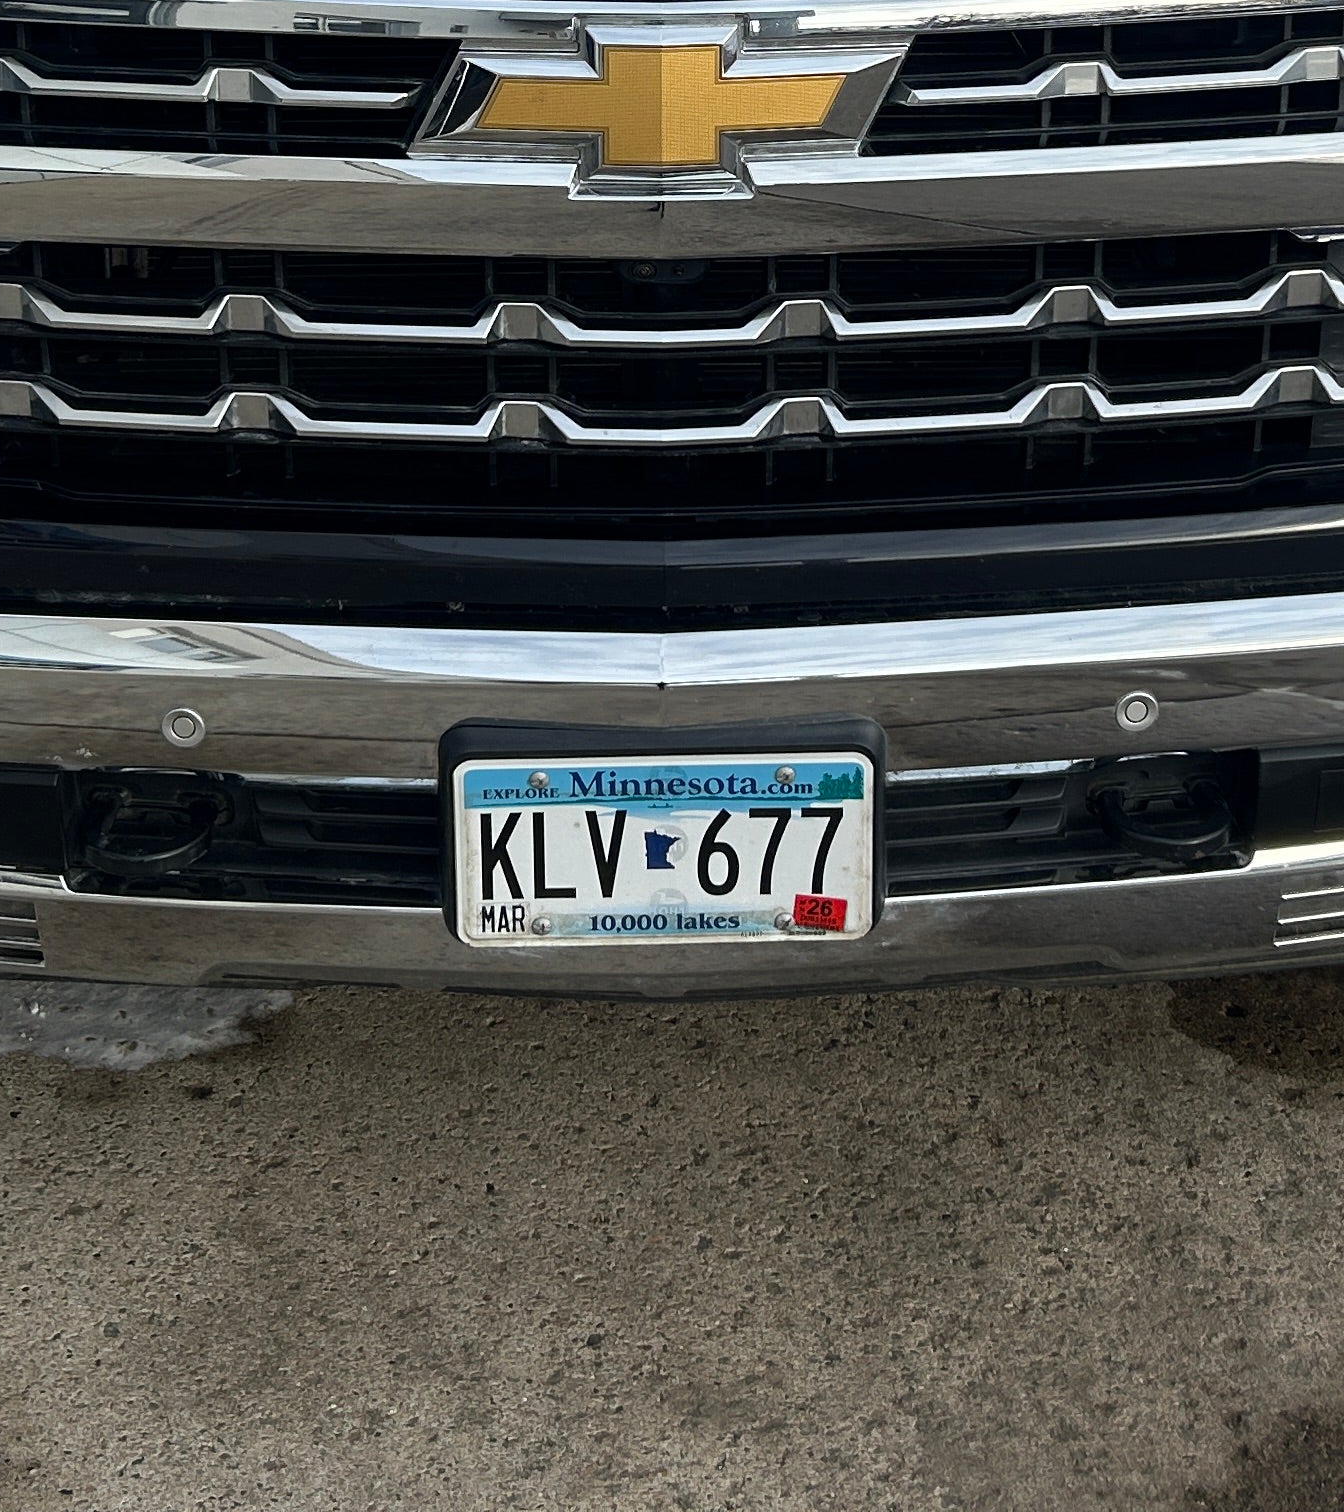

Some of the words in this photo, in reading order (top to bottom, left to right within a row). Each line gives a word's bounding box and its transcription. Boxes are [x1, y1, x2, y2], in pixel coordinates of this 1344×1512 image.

[482, 788, 560, 800] EXPLORE
[479, 809, 627, 901] KLV
[697, 807, 844, 896] 677
[806, 898, 833, 917] 26
[481, 905, 526, 933] MAR
[589, 914, 668, 933] 10,000
[676, 912, 740, 930] lakes
